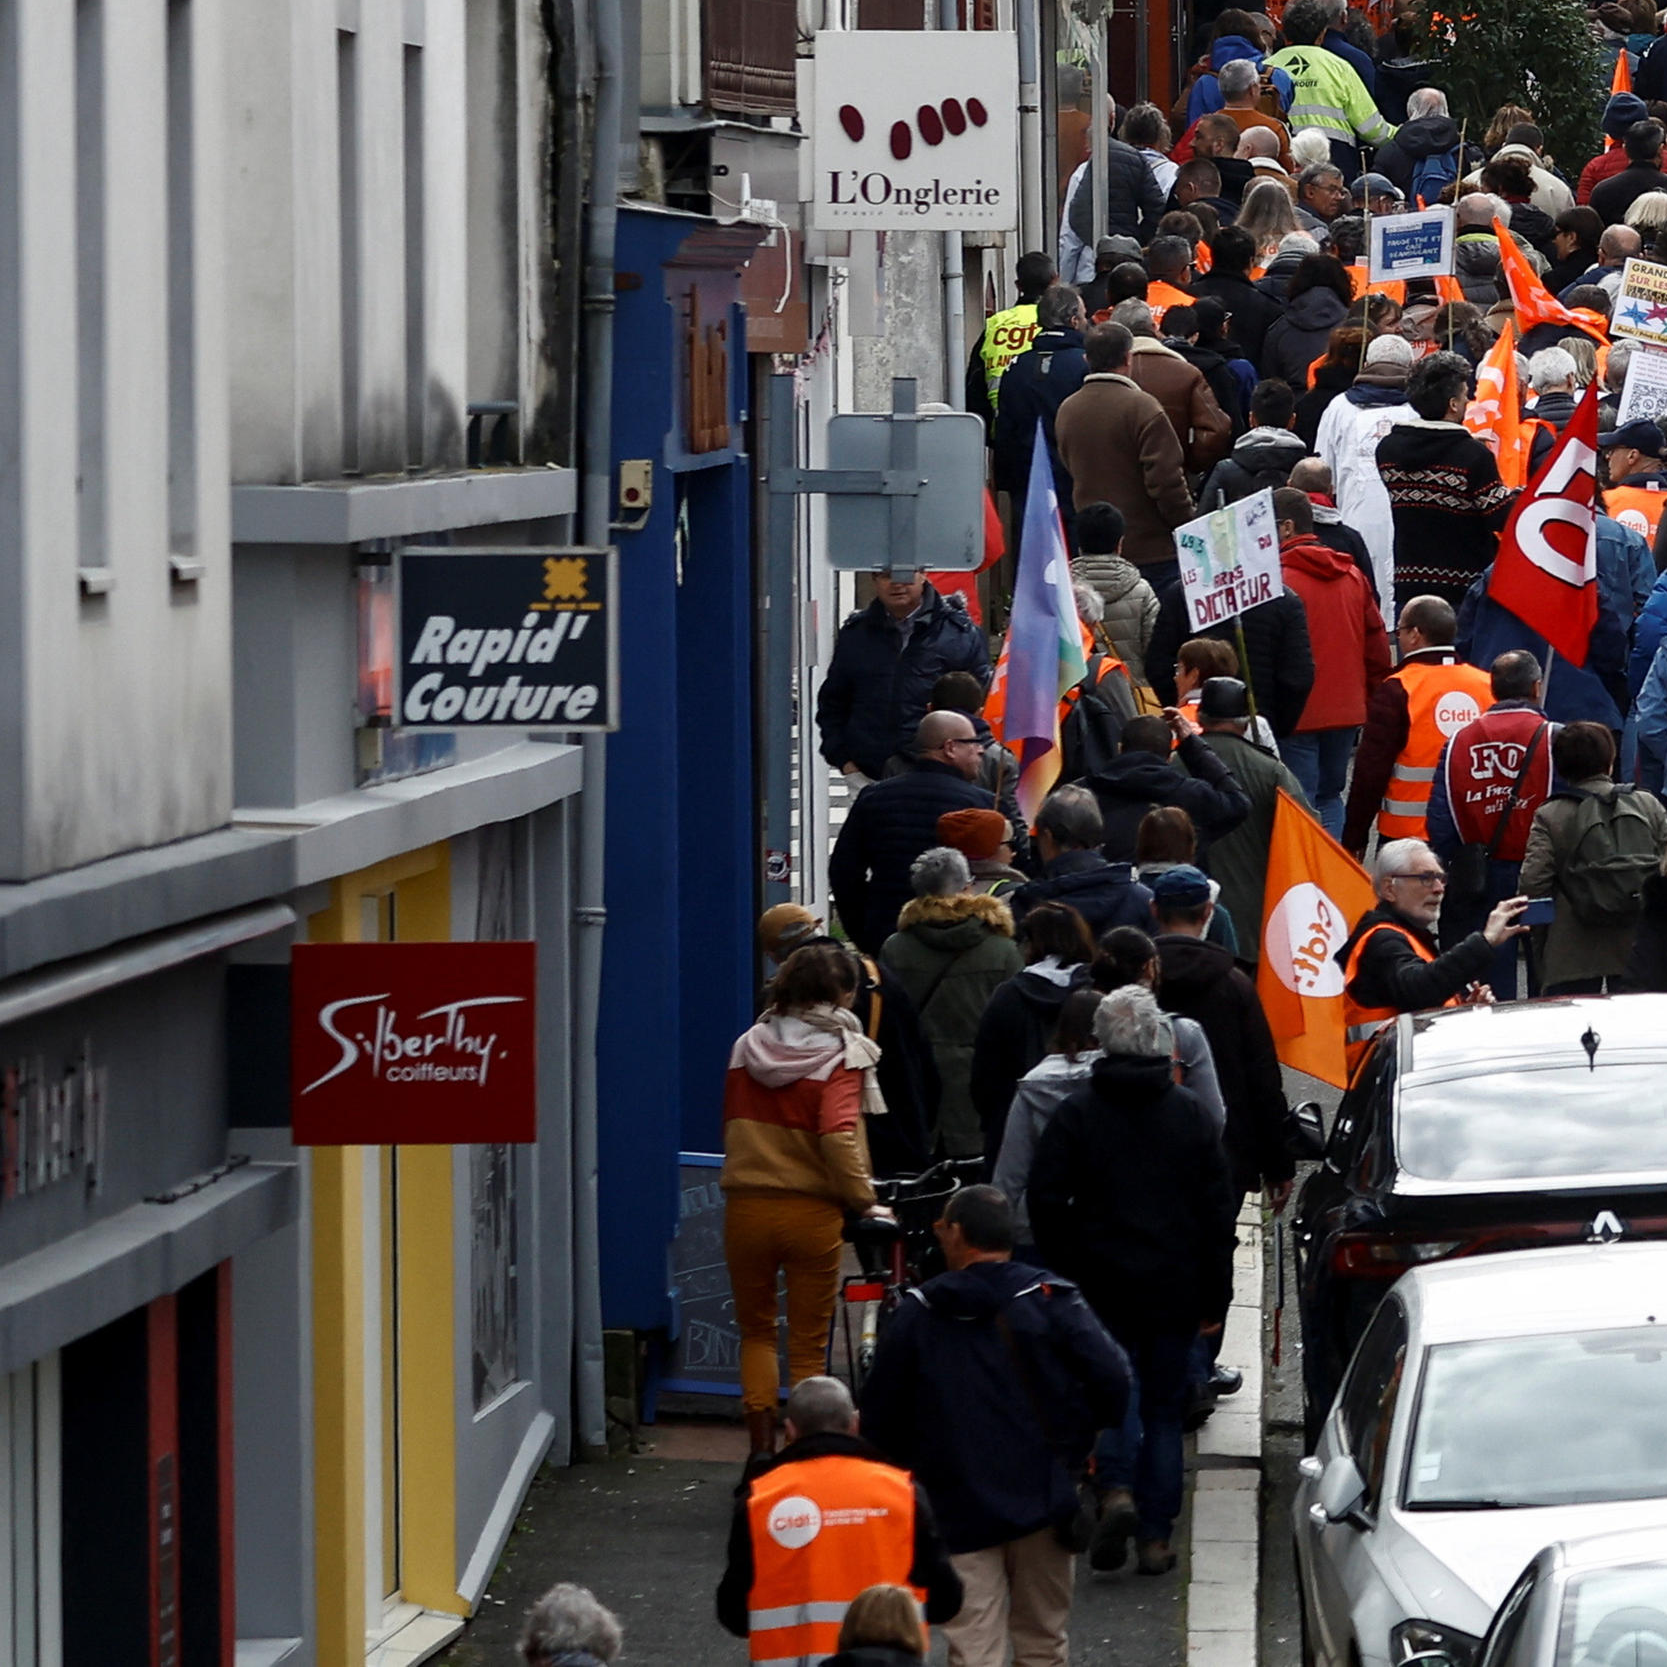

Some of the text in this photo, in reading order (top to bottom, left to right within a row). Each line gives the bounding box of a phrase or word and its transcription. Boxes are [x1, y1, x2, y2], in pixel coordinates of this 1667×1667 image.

[827, 170, 1001, 215] L'Onglerie
[1630, 275, 1648, 288] SUR
[1650, 279, 1667, 291] LES
[991, 323, 1041, 350] cgt
[1183, 569, 1197, 586] LES
[1193, 574, 1274, 627] DICTATEUR
[409, 611, 590, 678] Rapid'
[403, 671, 600, 724] Couture
[1469, 742, 1527, 780] FO
[386, 1062, 481, 1083] coiffeurs
